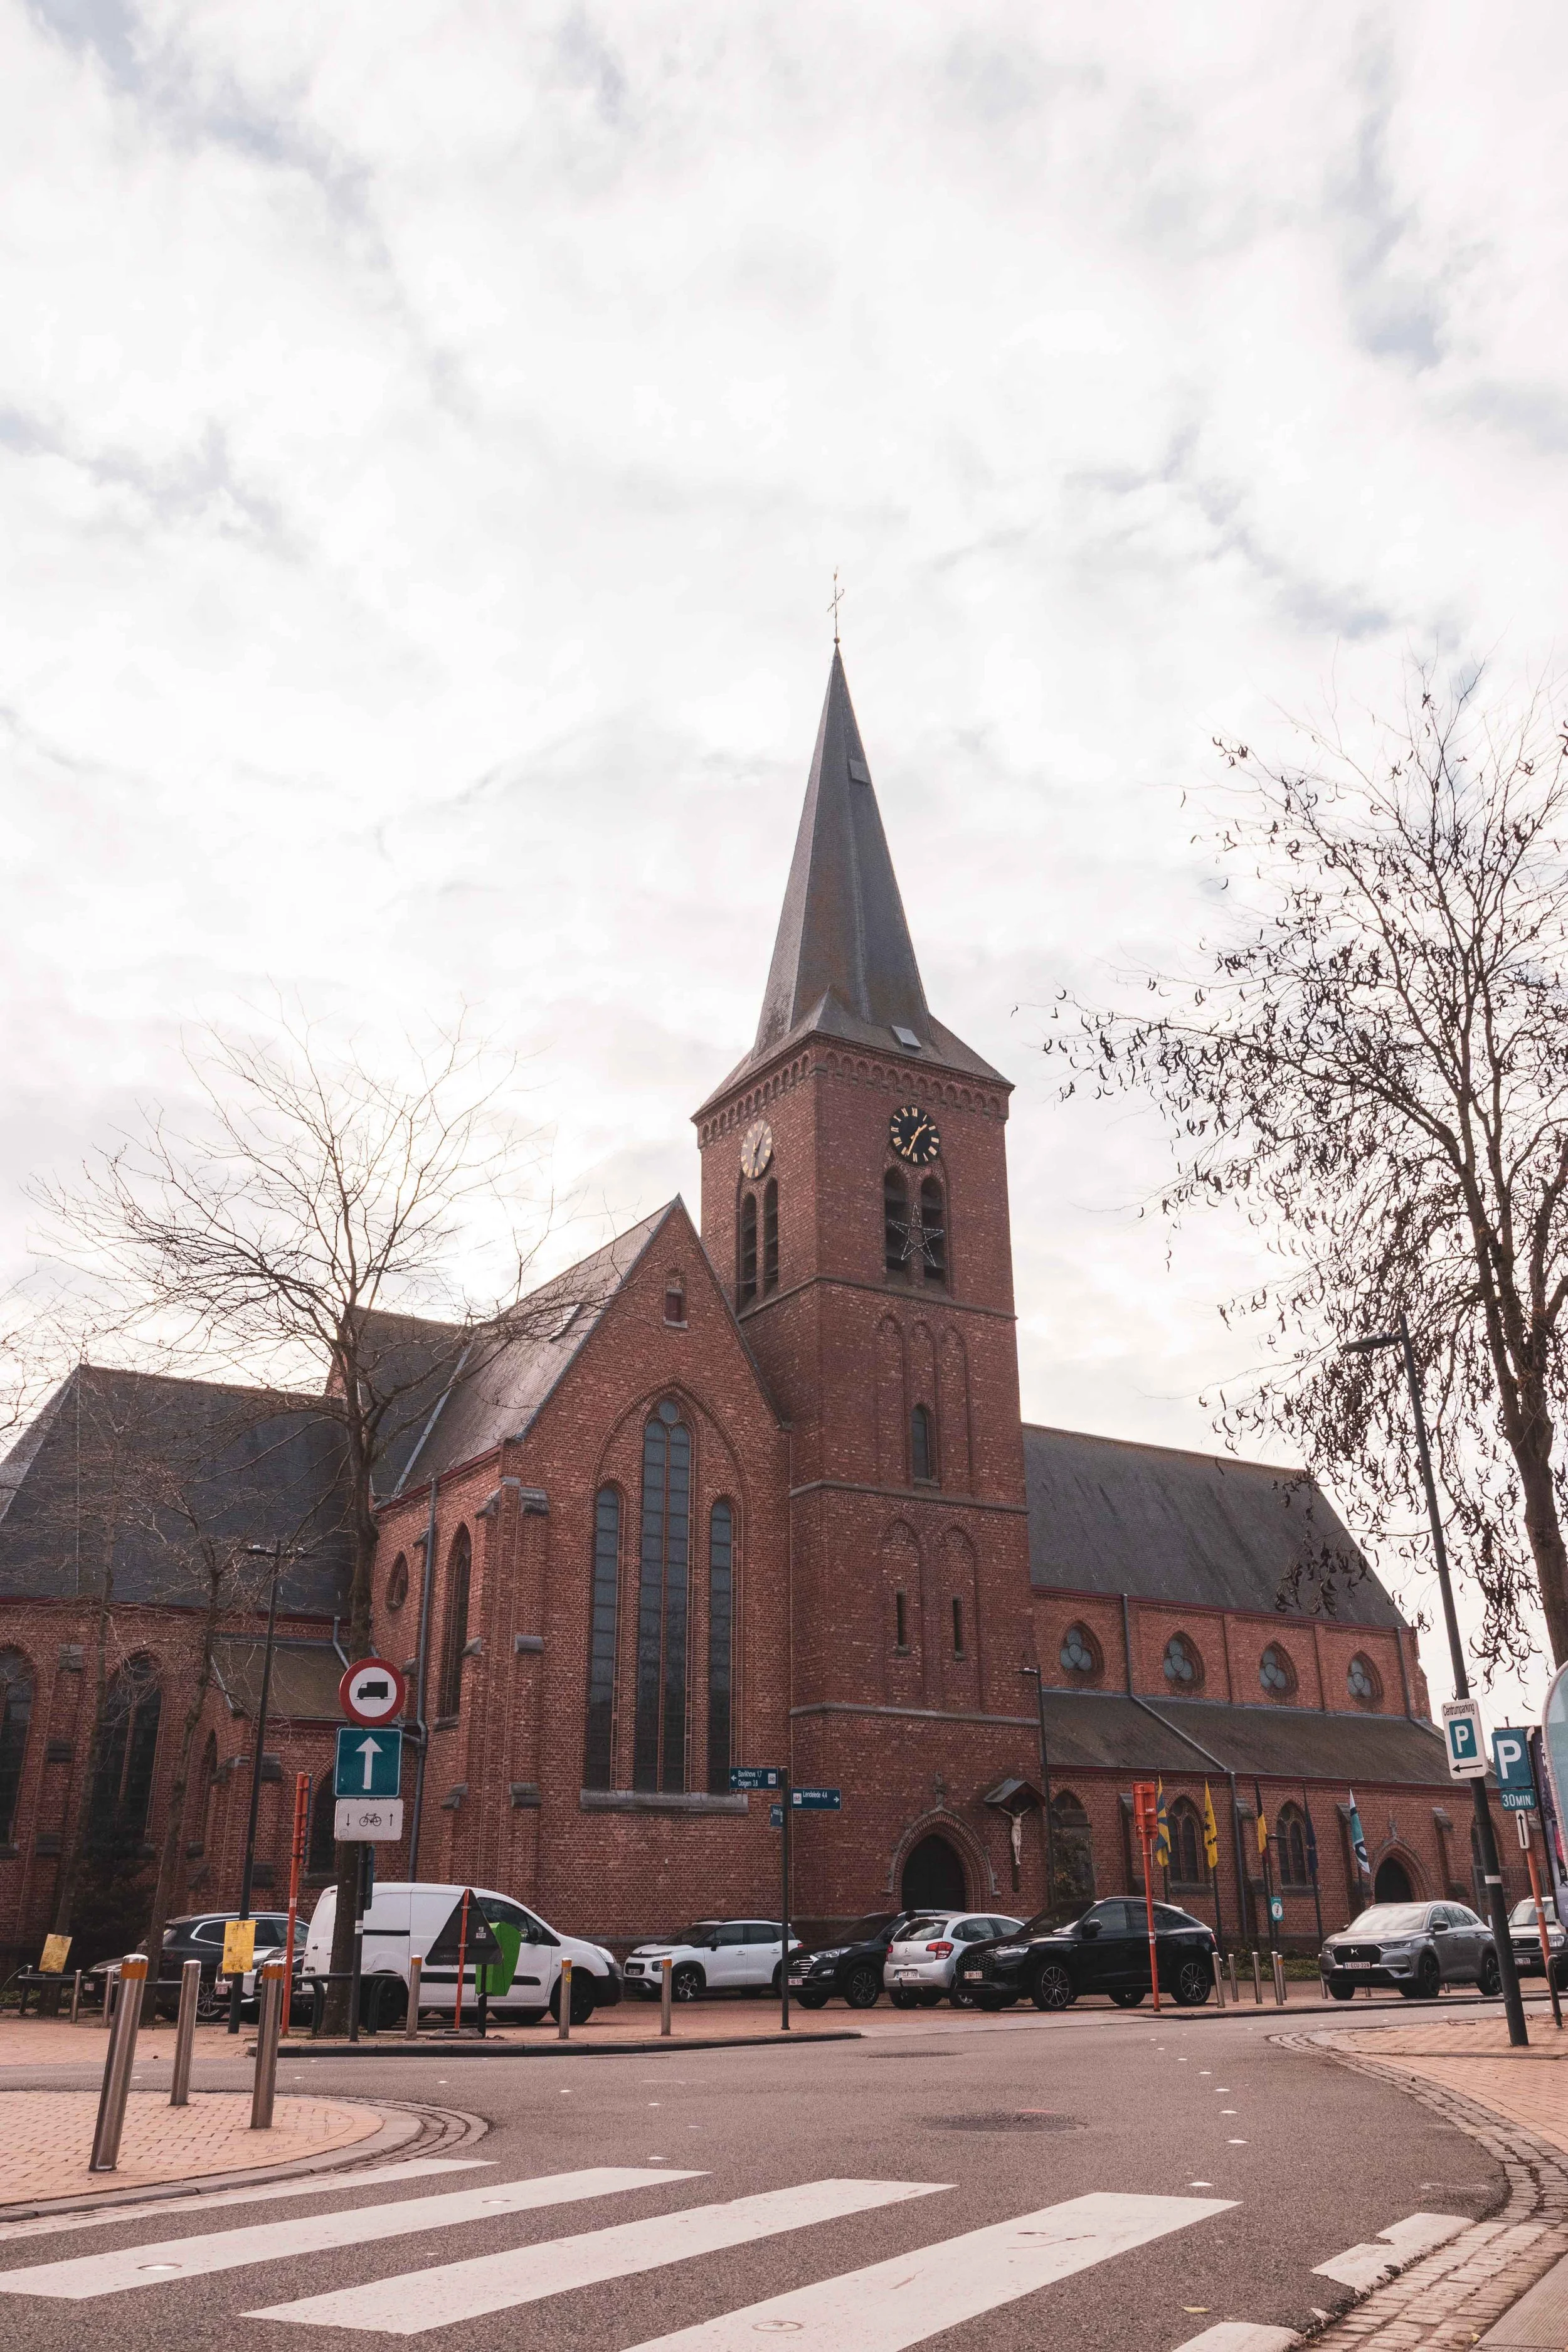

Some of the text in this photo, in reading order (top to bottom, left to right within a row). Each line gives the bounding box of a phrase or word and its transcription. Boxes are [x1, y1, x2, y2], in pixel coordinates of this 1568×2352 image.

[1443, 1702, 1475, 1717] Centrumparking
[1454, 1725, 1469, 1753] P
[1496, 1739, 1522, 1779] P
[738, 1779, 752, 1788] Ooigem
